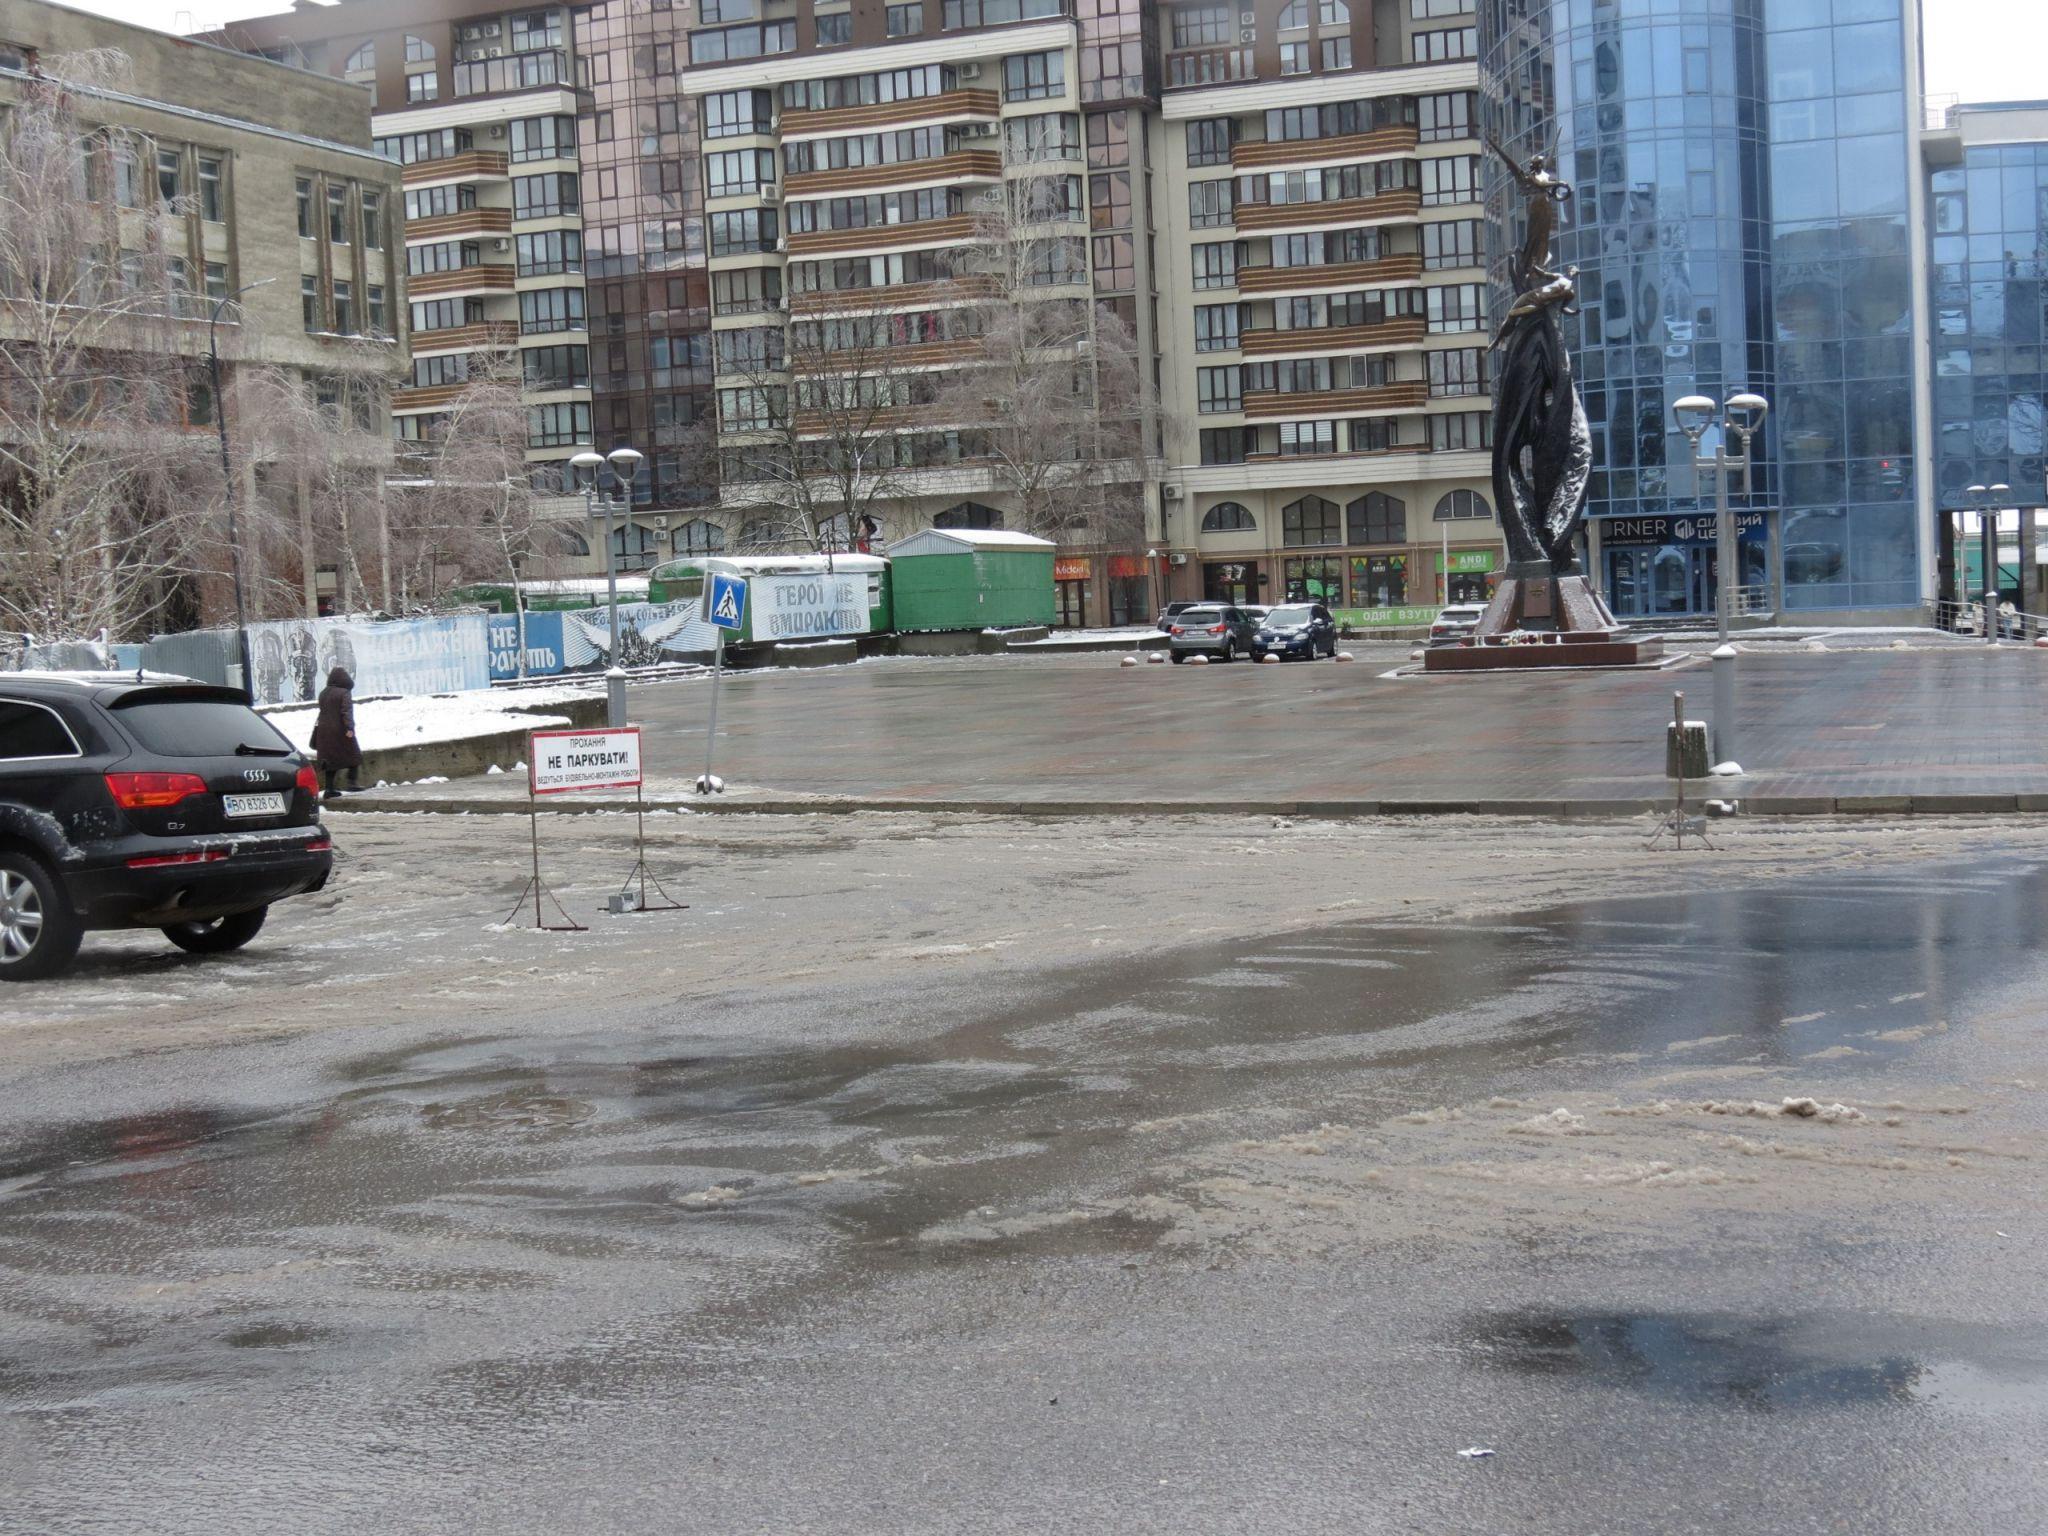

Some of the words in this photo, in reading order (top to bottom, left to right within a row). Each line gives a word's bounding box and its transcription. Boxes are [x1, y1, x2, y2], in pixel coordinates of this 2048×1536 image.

[1460, 555, 1486, 565] ANDI
[775, 578, 824, 606] ГЕРОЇ
[836, 582, 854, 603] НЕ
[1363, 611, 1393, 622] ОДЯГ
[490, 626, 518, 648] НЕ
[570, 737, 606, 748] ПРОХАННЯ
[548, 756, 562, 769] НЕ
[567, 752, 629, 767] ПАРКУВАТИ!
[537, 775, 563, 784] ВЕДУТЬСЯ
[248, 798, 268, 810] 8328
[168, 822, 186, 830] Q7
